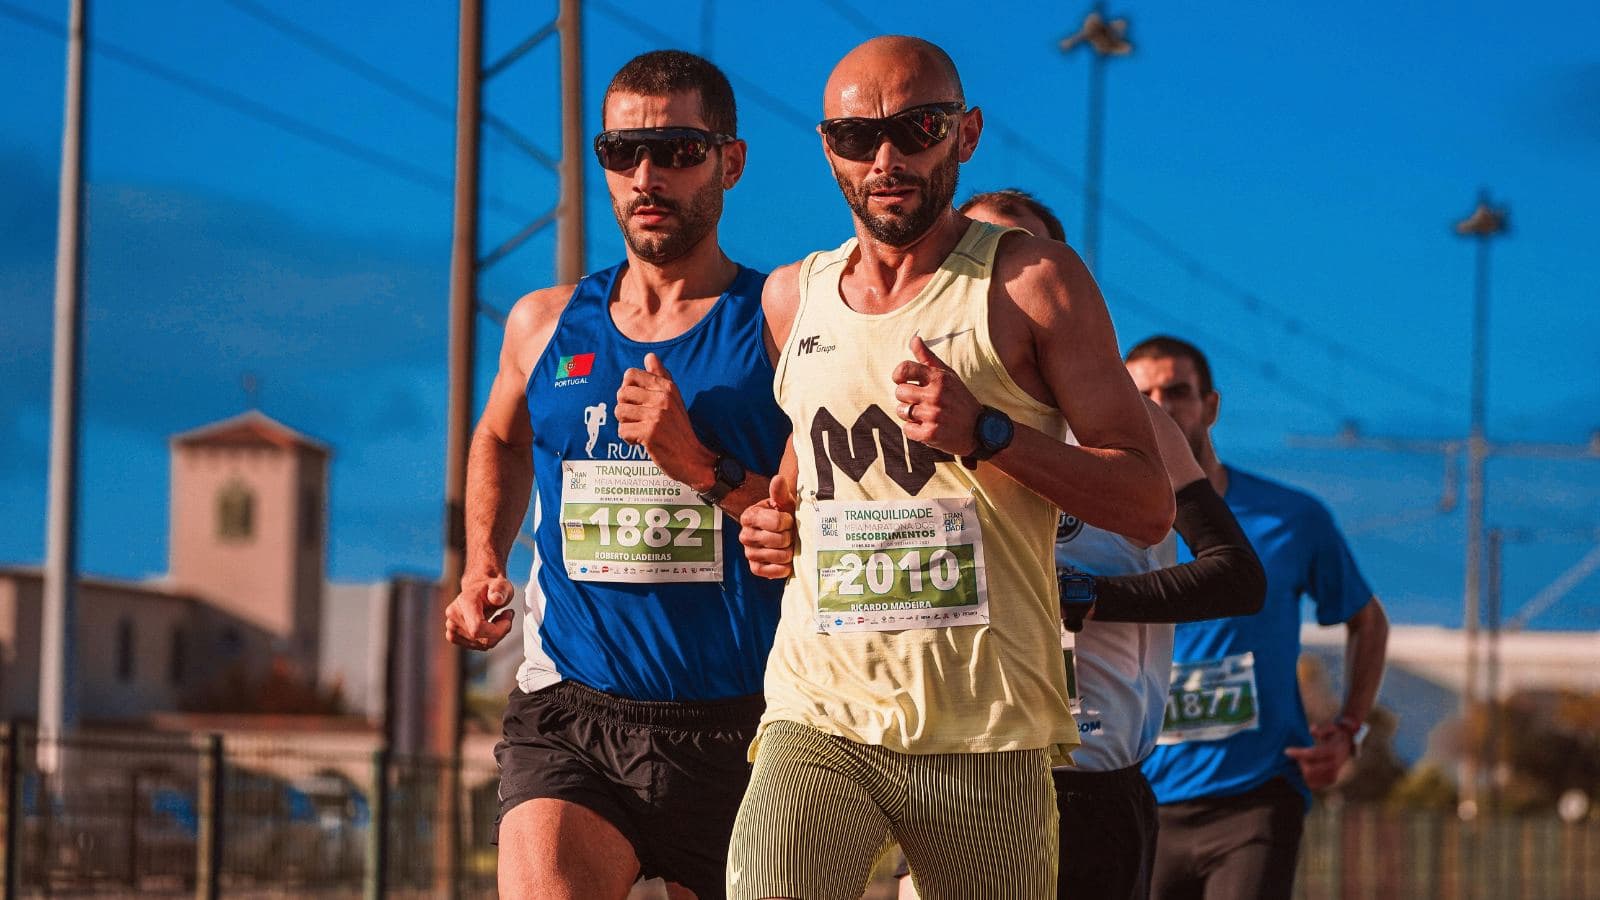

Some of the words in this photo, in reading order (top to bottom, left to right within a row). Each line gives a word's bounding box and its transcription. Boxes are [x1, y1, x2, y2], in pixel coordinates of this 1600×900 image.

[797, 335, 820, 356] MF
[554, 377, 589, 388] PORTUGAL
[607, 442, 651, 459] RUN
[614, 479, 661, 487] MARATONA
[594, 487, 681, 496] DESCOBRIMENTOS
[844, 508, 934, 521] TRANQUILIDADE
[589, 507, 703, 548] 1882
[864, 522, 914, 531] MARATONA
[845, 529, 936, 541] DESCOBRIMENTOS
[594, 551, 629, 560] ROBERTO
[631, 552, 672, 561] LADEIRAS
[838, 549, 960, 595] 2010
[851, 602, 888, 612] RICARDO
[890, 600, 933, 611] MADEIRA
[1167, 686, 1241, 719] 1877
